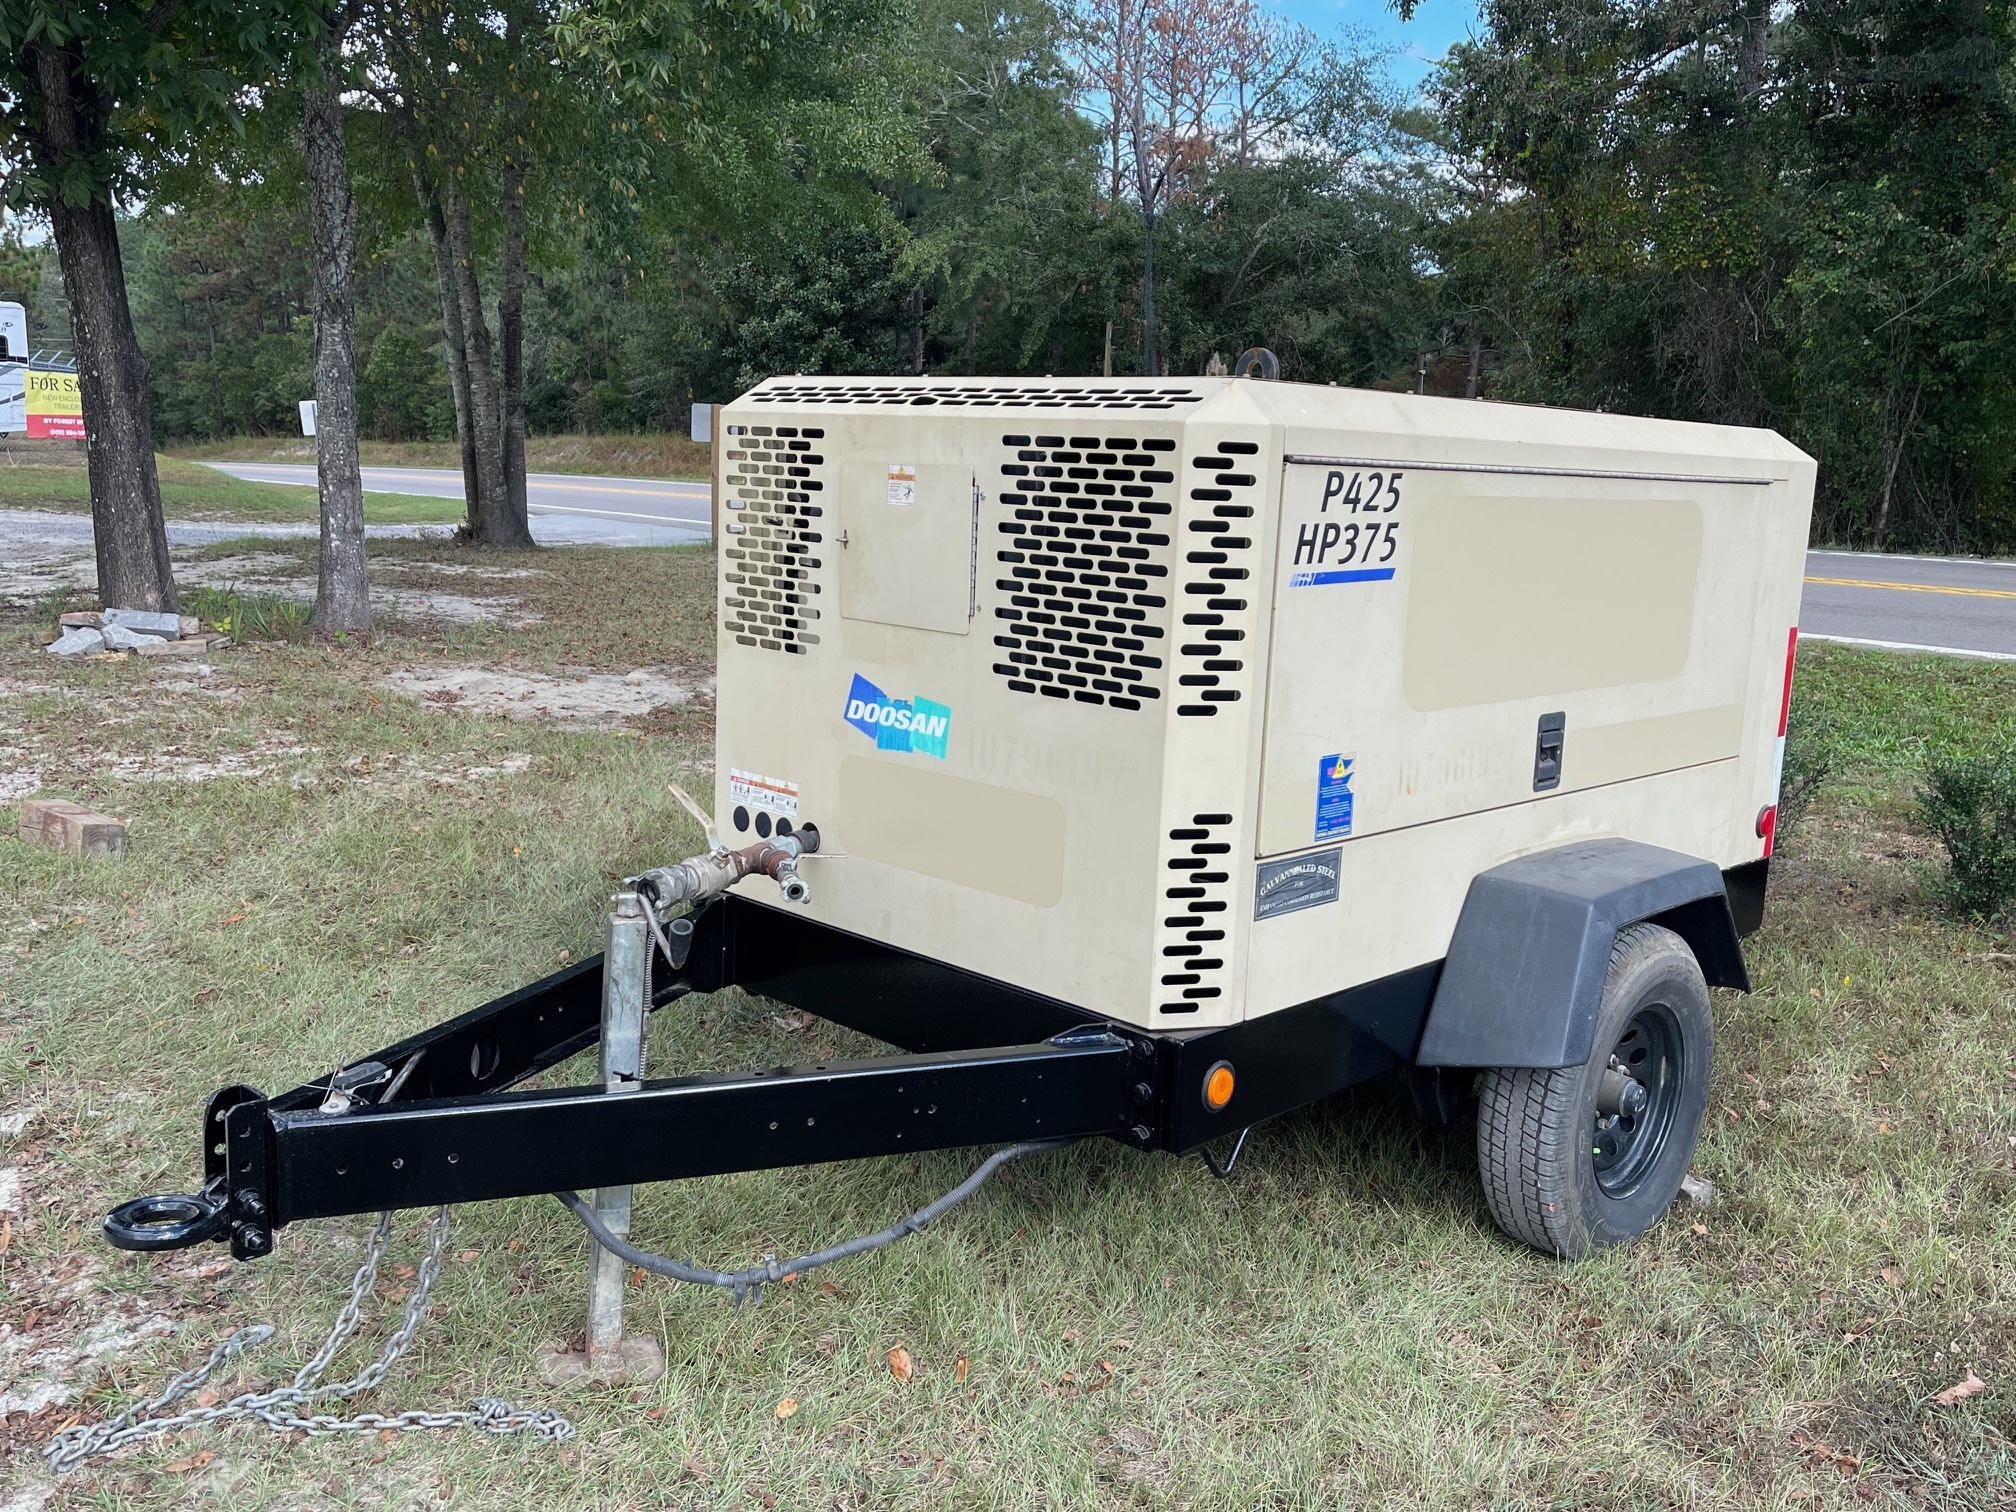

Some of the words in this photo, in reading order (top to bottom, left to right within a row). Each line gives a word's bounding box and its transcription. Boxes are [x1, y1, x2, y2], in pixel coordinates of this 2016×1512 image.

[30, 377, 59, 391] FOR
[1321, 471, 1404, 514] P425
[1293, 522, 1400, 565] HP375
[847, 699, 947, 738] DOOSAN
[1317, 865, 1336, 879] STEEL
